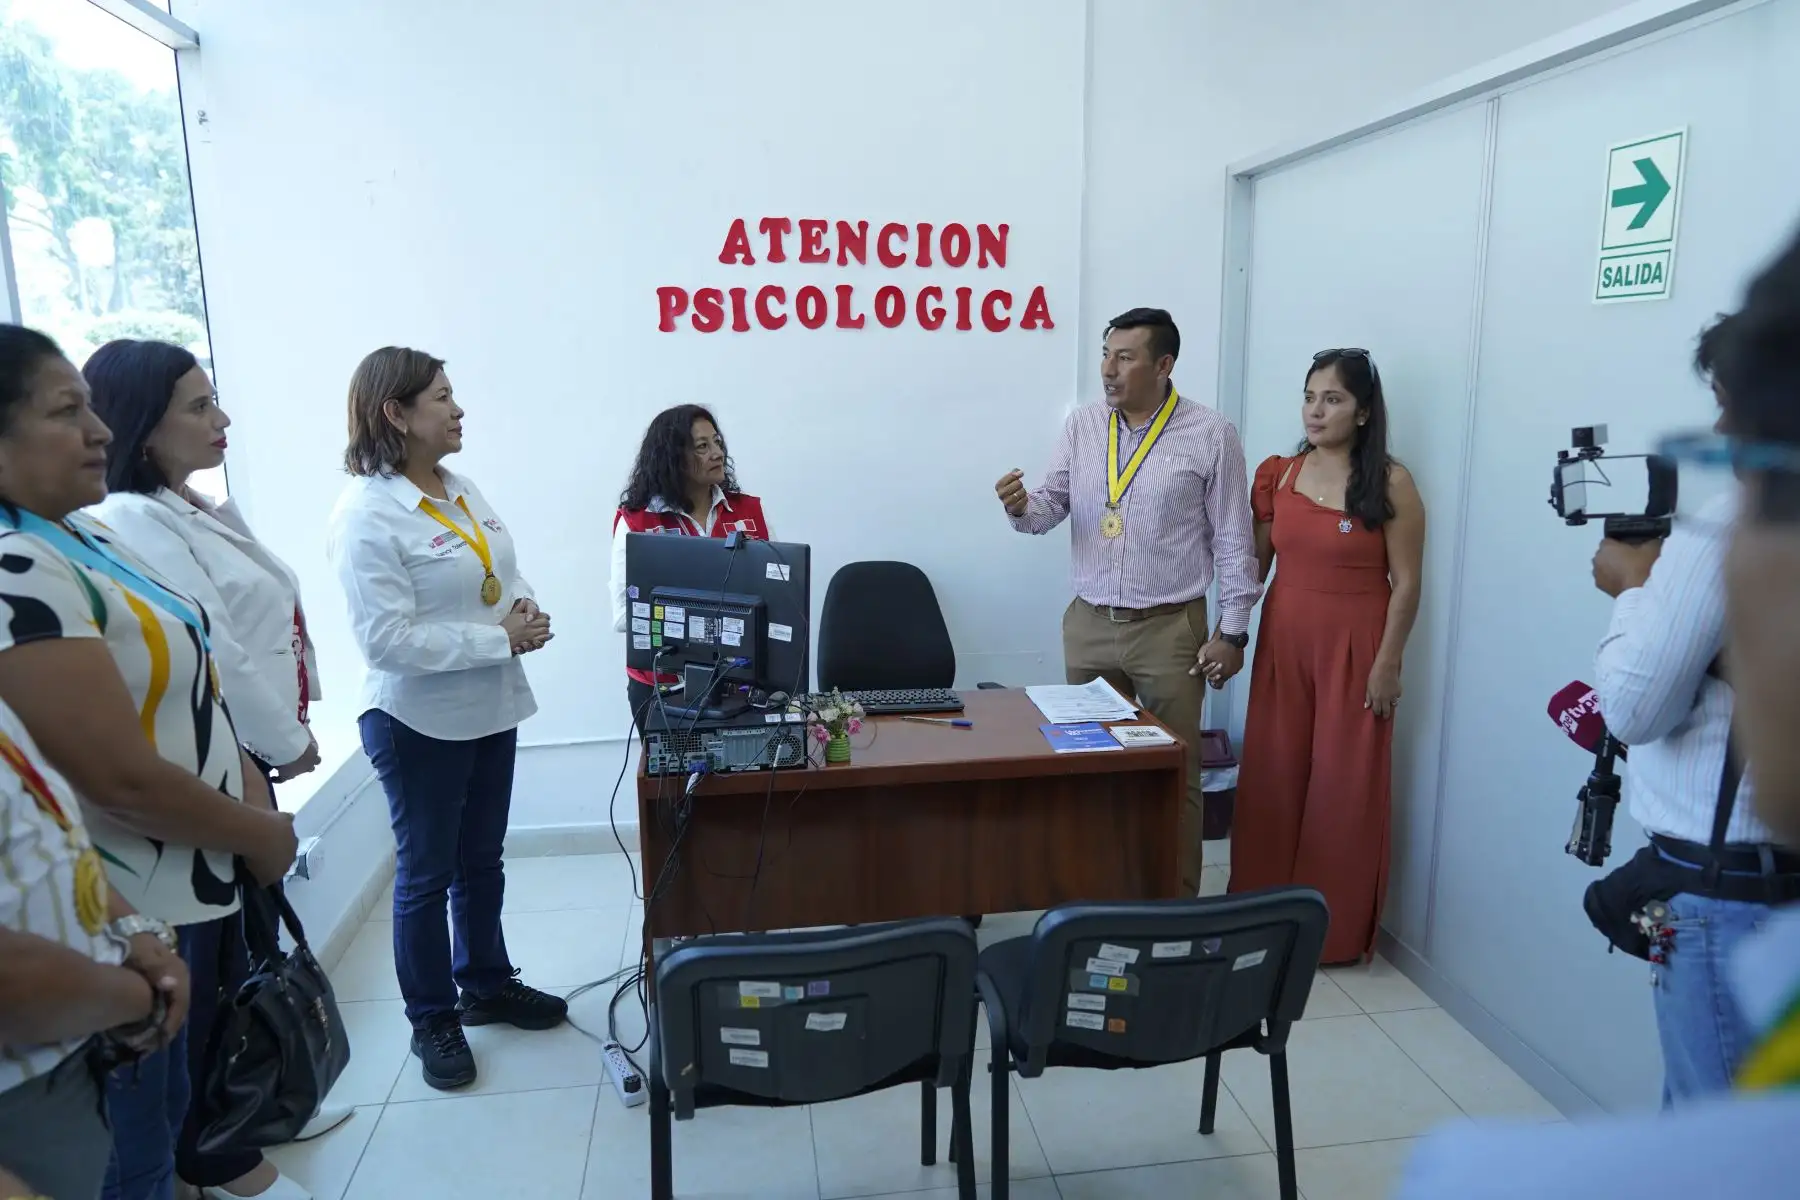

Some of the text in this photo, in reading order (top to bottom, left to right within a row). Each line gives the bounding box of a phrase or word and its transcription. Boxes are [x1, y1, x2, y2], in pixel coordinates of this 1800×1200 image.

[718, 217, 1010, 269] ATENCION
[1602, 261, 1662, 288] SALIDA
[656, 284, 1055, 333] PSICOLOGICA
